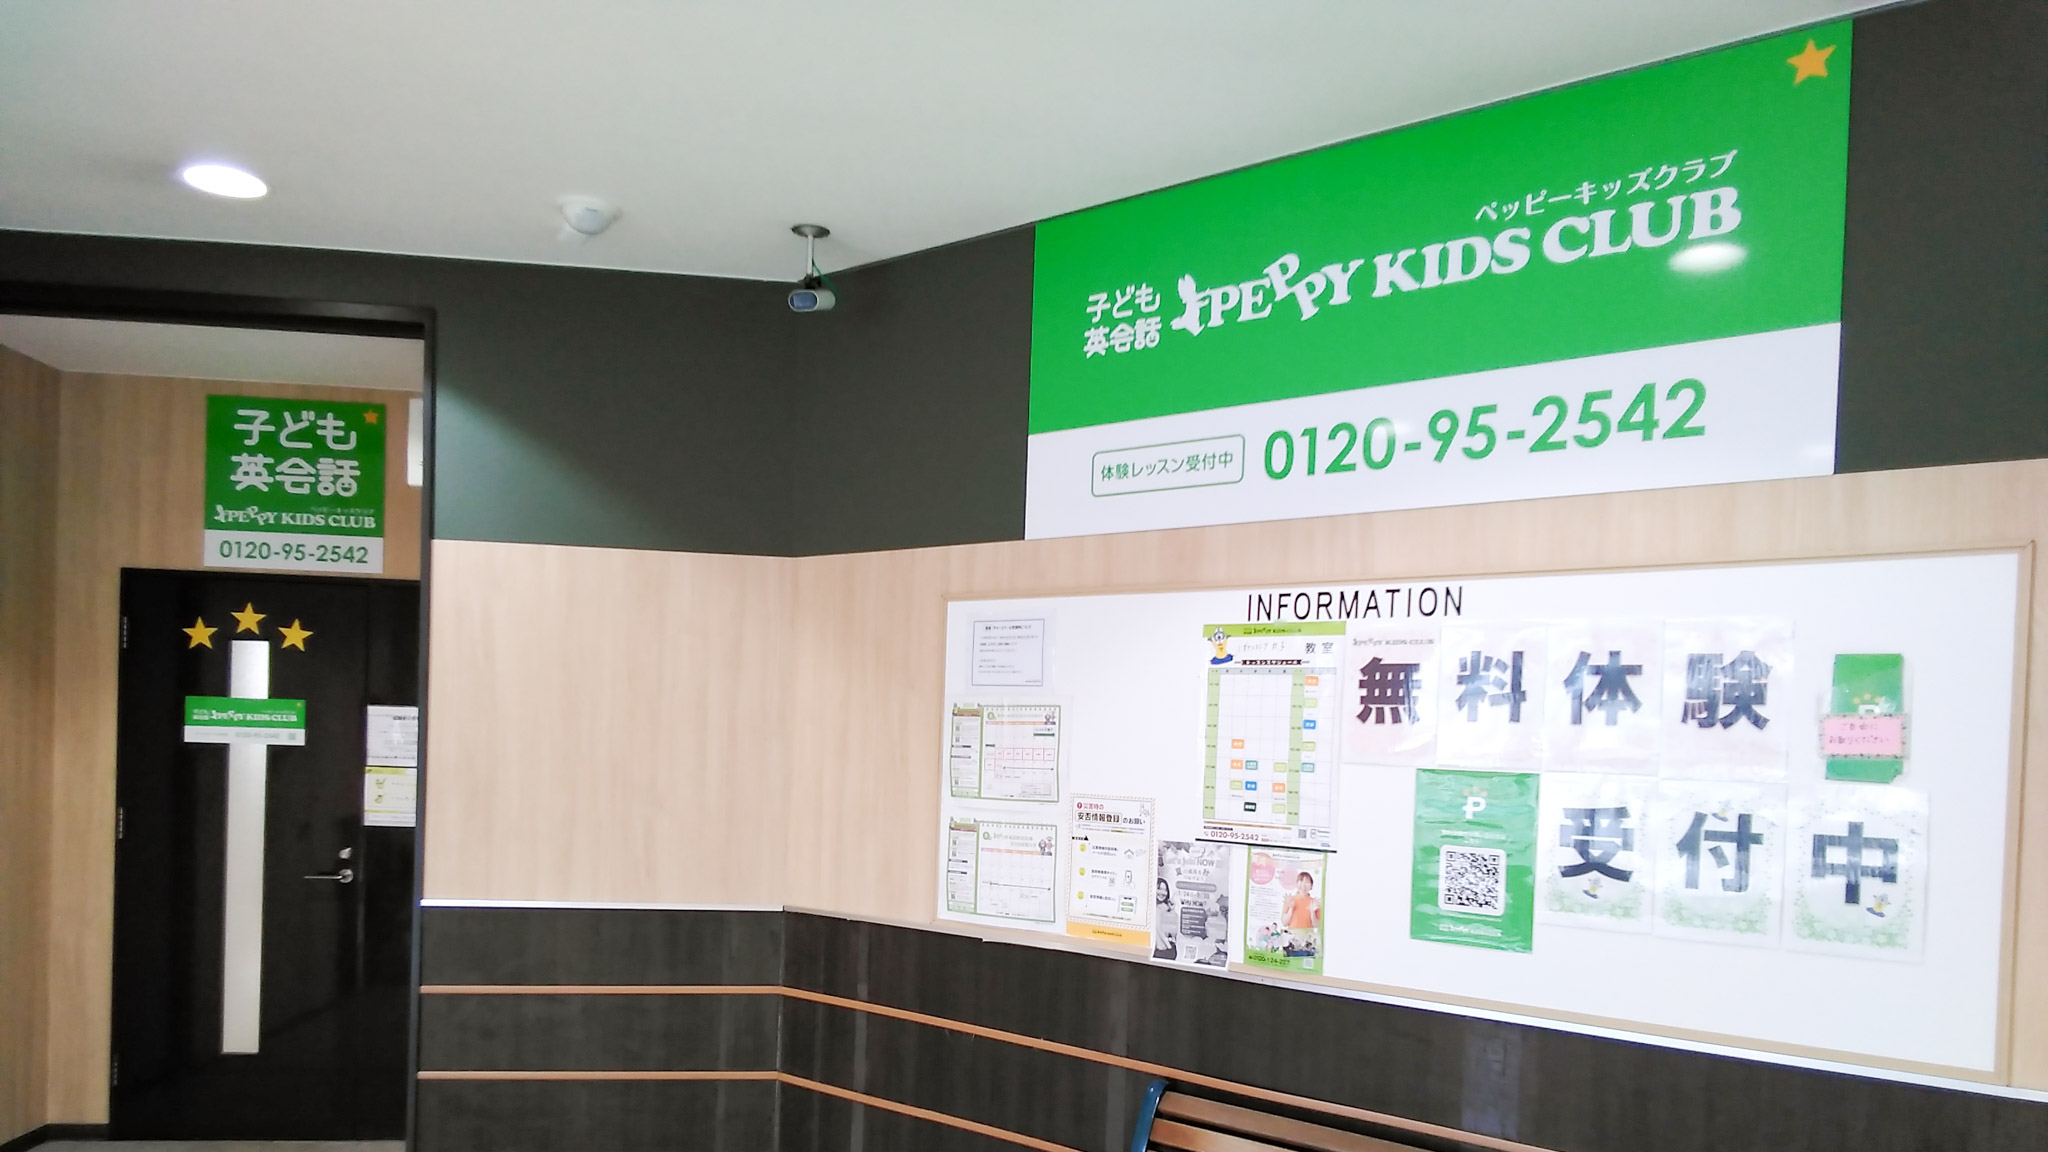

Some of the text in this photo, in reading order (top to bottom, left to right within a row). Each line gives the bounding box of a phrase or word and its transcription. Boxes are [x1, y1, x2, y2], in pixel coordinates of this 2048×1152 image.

[1474, 149, 1738, 221] ペッピーキッズクラブ
[1205, 186, 1742, 328] PEPPY KIDS CLUB
[1086, 282, 1161, 324] 子ども
[1083, 315, 1162, 359] 英会話
[234, 409, 357, 450] 子ども
[1264, 378, 1707, 480] 0120-95-2542
[230, 453, 361, 497] 英会話
[1100, 451, 1234, 482] 体験レッスン受付中
[224, 505, 377, 528] PEPPY KIDS CLUB
[219, 540, 369, 564] 0120-95-2542
[1247, 586, 1463, 622] INFORMATION
[1210, 831, 1259, 841] 0120-95-2542
